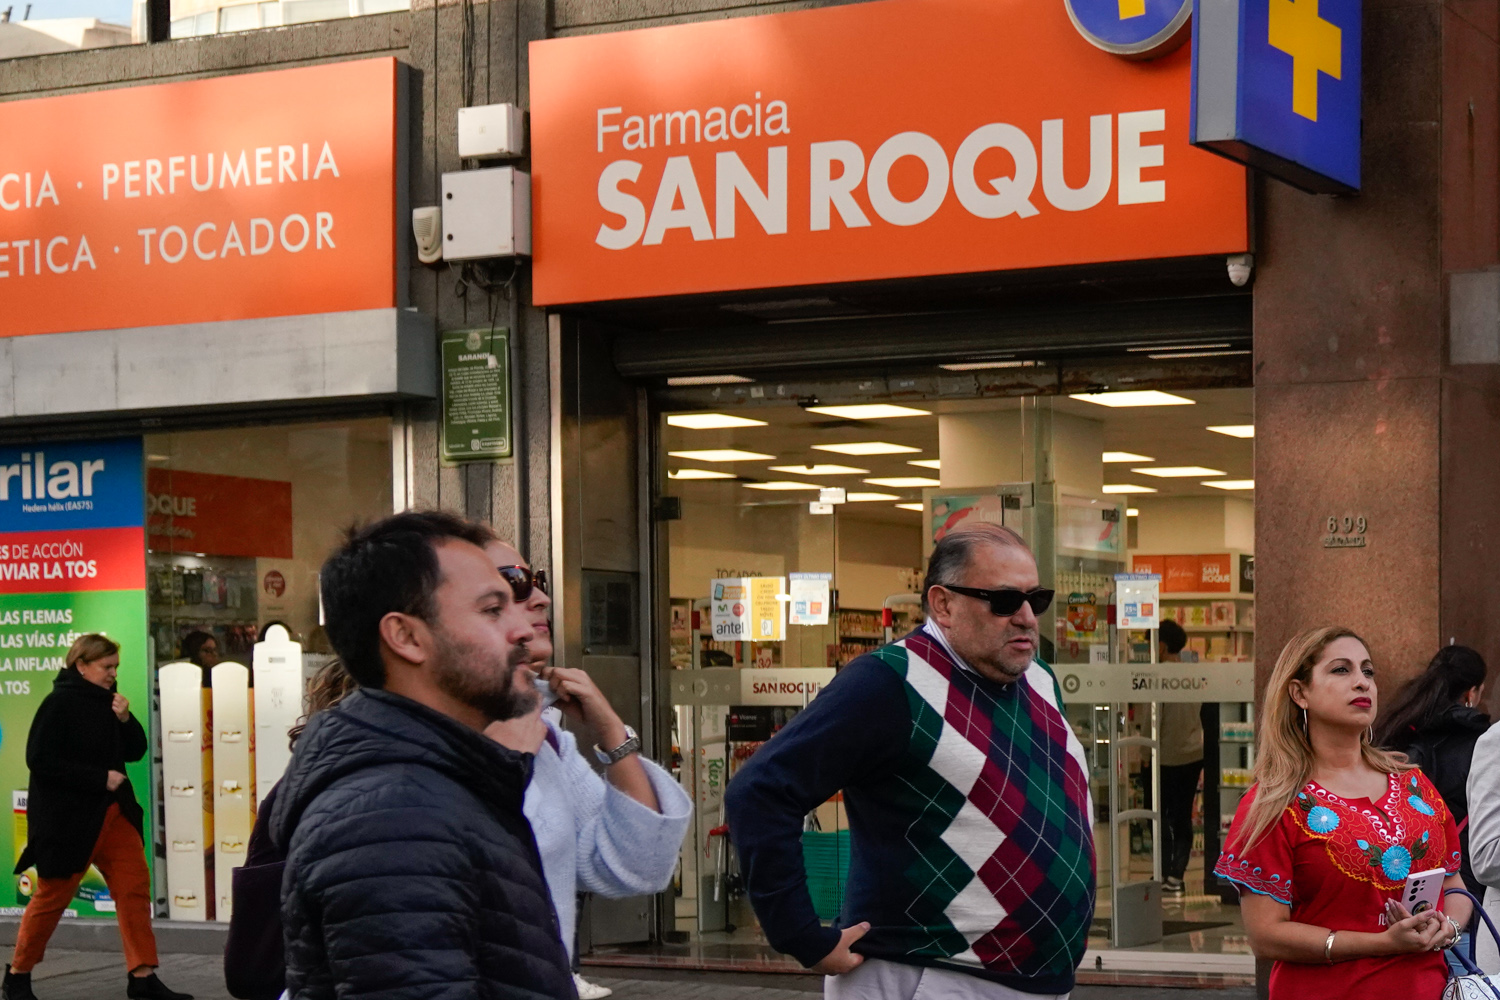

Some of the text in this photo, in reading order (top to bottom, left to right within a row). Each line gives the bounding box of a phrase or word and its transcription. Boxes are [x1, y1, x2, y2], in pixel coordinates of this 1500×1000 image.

[596, 91, 790, 152] Farmacia
[0, 140, 340, 211] CIA PERFUMERIA
[594, 109, 1166, 250] SAN ROQUE
[137, 211, 336, 265] TOCADOR
[1326, 515, 1368, 534] 699
[12, 543, 29, 559] DE
[32, 539, 84, 559] ACCIÓN
[43, 561, 64, 580] LA
[65, 559, 98, 579] TOS
[22, 608, 73, 625] FLEMAS
[716, 621, 745, 636] antel
[1, 633, 23, 649] LAS
[25, 630, 55, 648] VÍAS
[4, 679, 31, 695] TOS
[752, 682, 778, 694] SAN
[1161, 678, 1207, 690] ROQU
